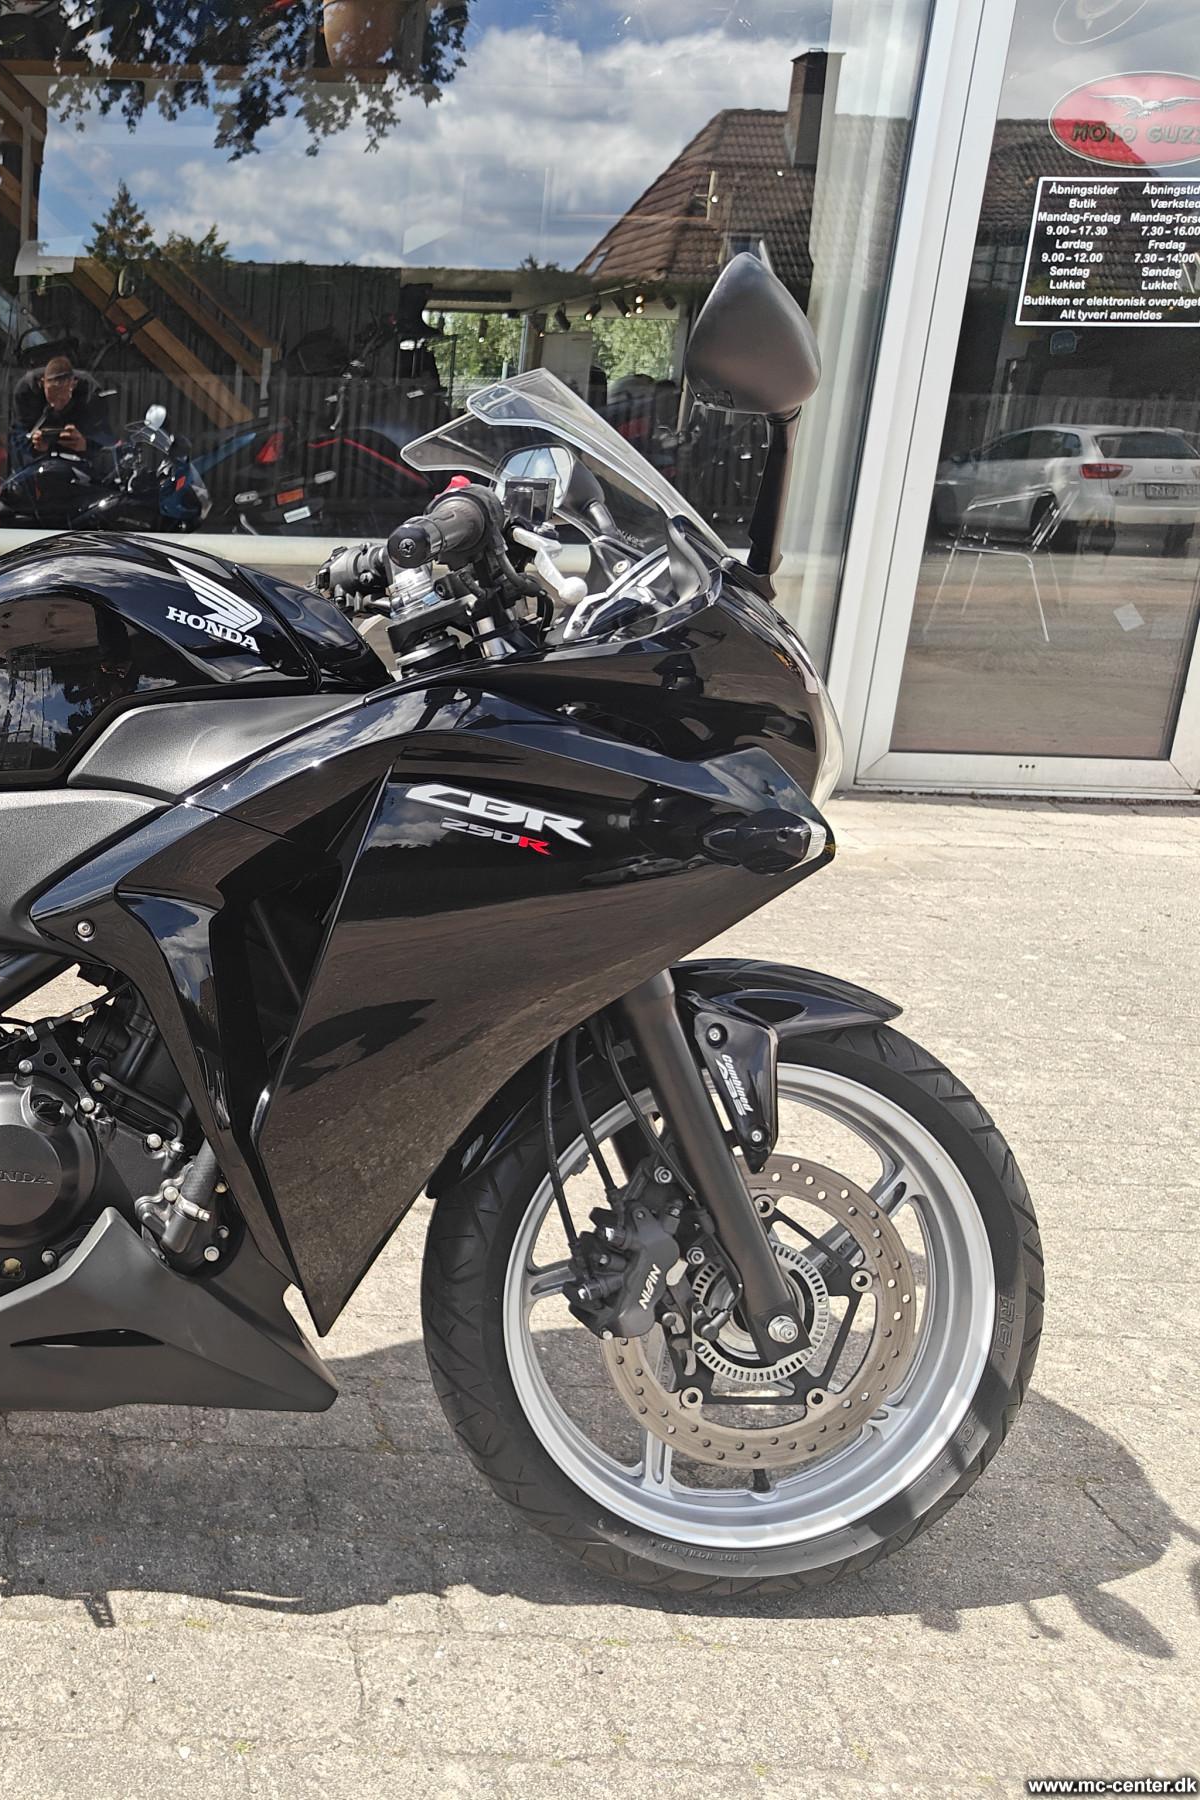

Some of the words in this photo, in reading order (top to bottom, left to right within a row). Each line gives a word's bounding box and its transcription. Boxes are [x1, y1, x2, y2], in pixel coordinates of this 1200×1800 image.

[1072, 122, 1138, 143] MOTO
[1049, 182, 1119, 197] Åbningstider
[1069, 199, 1097, 209] Butik
[1038, 211, 1121, 225] Mandag-Fredag
[1055, 239, 1093, 251] Lørdag
[1148, 239, 1186, 252] Fredag
[1049, 266, 1090, 278] Søndag
[1141, 266, 1182, 279] Søndag
[1049, 280, 1086, 290] Lukket
[1141, 280, 1178, 290] Lukket
[1023, 295, 1070, 306] Butikken
[1072, 297, 1085, 306] er
[1086, 296, 1146, 307] elektronisk
[1060, 309, 1076, 320] Alt
[1078, 310, 1108, 322] tyveri
[1110, 310, 1162, 320] anmeldes
[166, 605, 261, 654] HONDA
[405, 784, 592, 847] CBR
[440, 817, 552, 856] 250R
[715, 1058, 747, 1116] ABS
[721, 1053, 754, 1112] Combined
